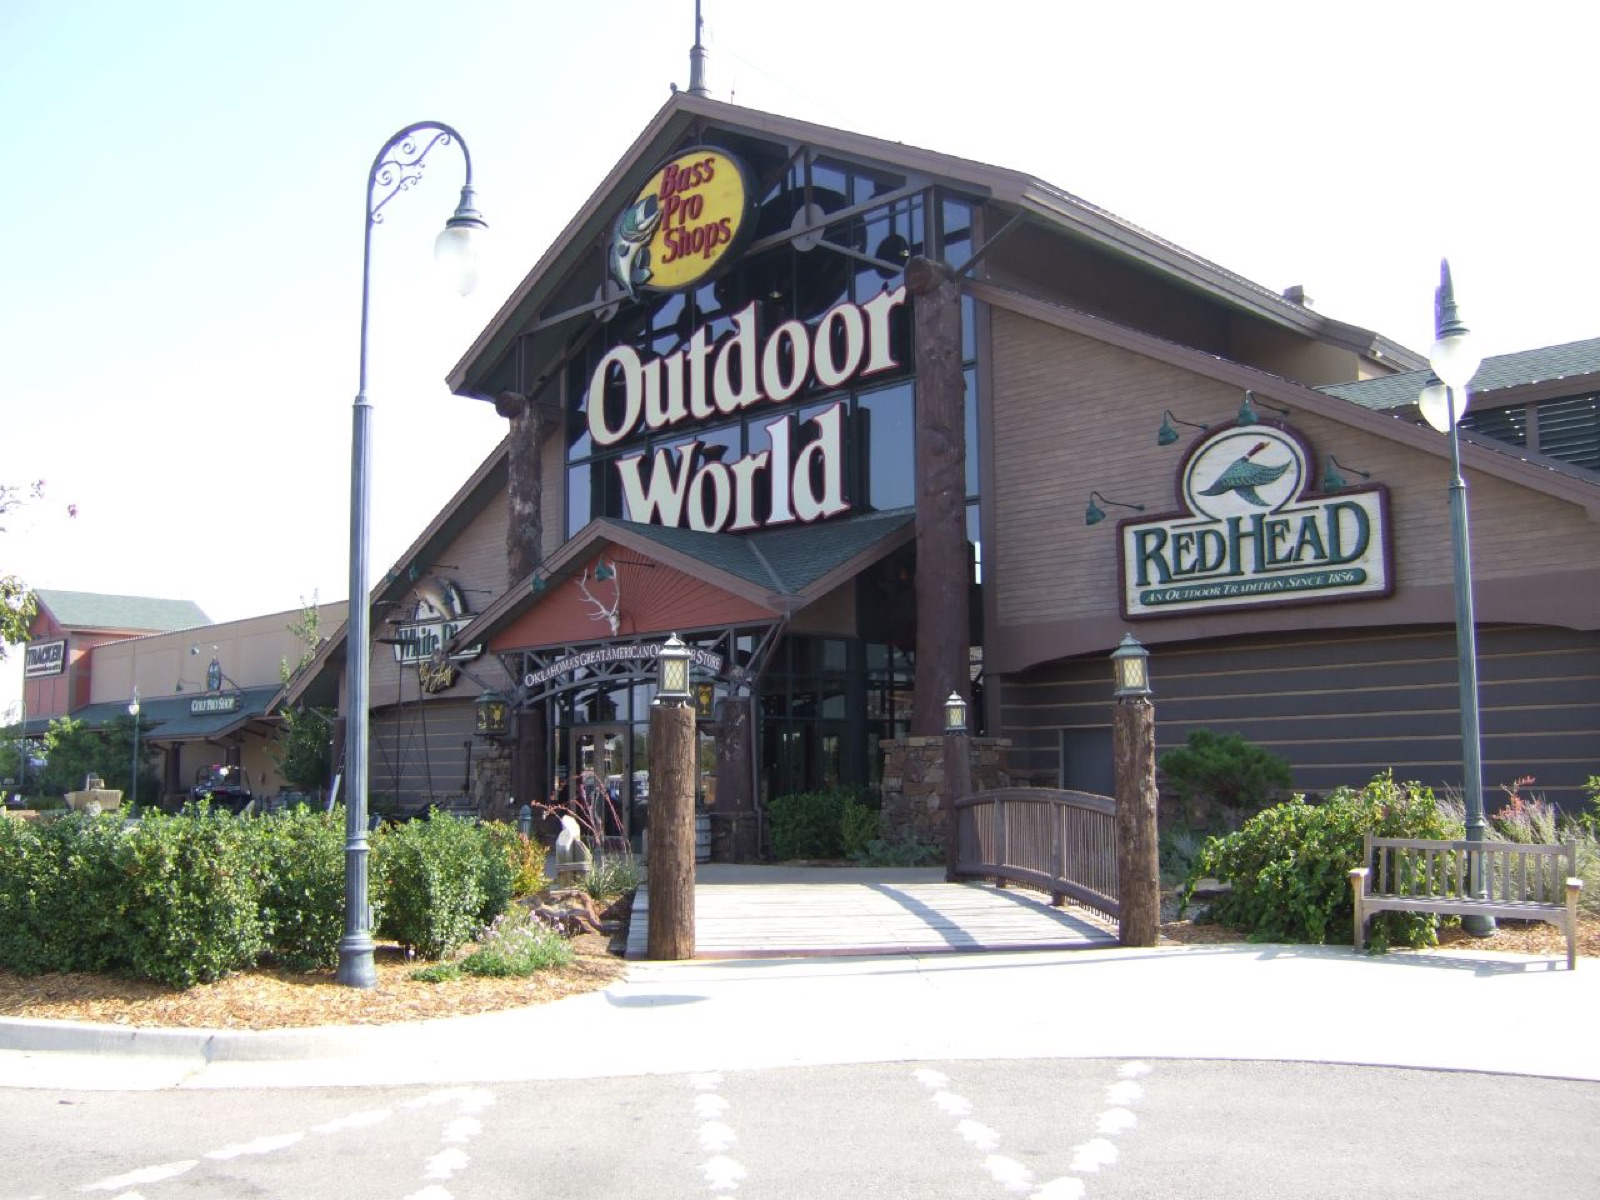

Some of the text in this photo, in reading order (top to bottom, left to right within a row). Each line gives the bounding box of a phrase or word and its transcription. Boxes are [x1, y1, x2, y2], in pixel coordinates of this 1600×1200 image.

[658, 156, 716, 201] Bass
[661, 193, 704, 231] Pro
[661, 216, 732, 264] Shops
[586, 284, 908, 446] Outdoor
[616, 400, 851, 534] World
[1133, 500, 1371, 587] REDHEAD
[1146, 571, 1356, 602] AN OUTDOOR TRADITION SINCE 1856
[579, 649, 605, 666] GREAT
[605, 645, 650, 661] AMERICAN
[696, 649, 721, 670] STORE
